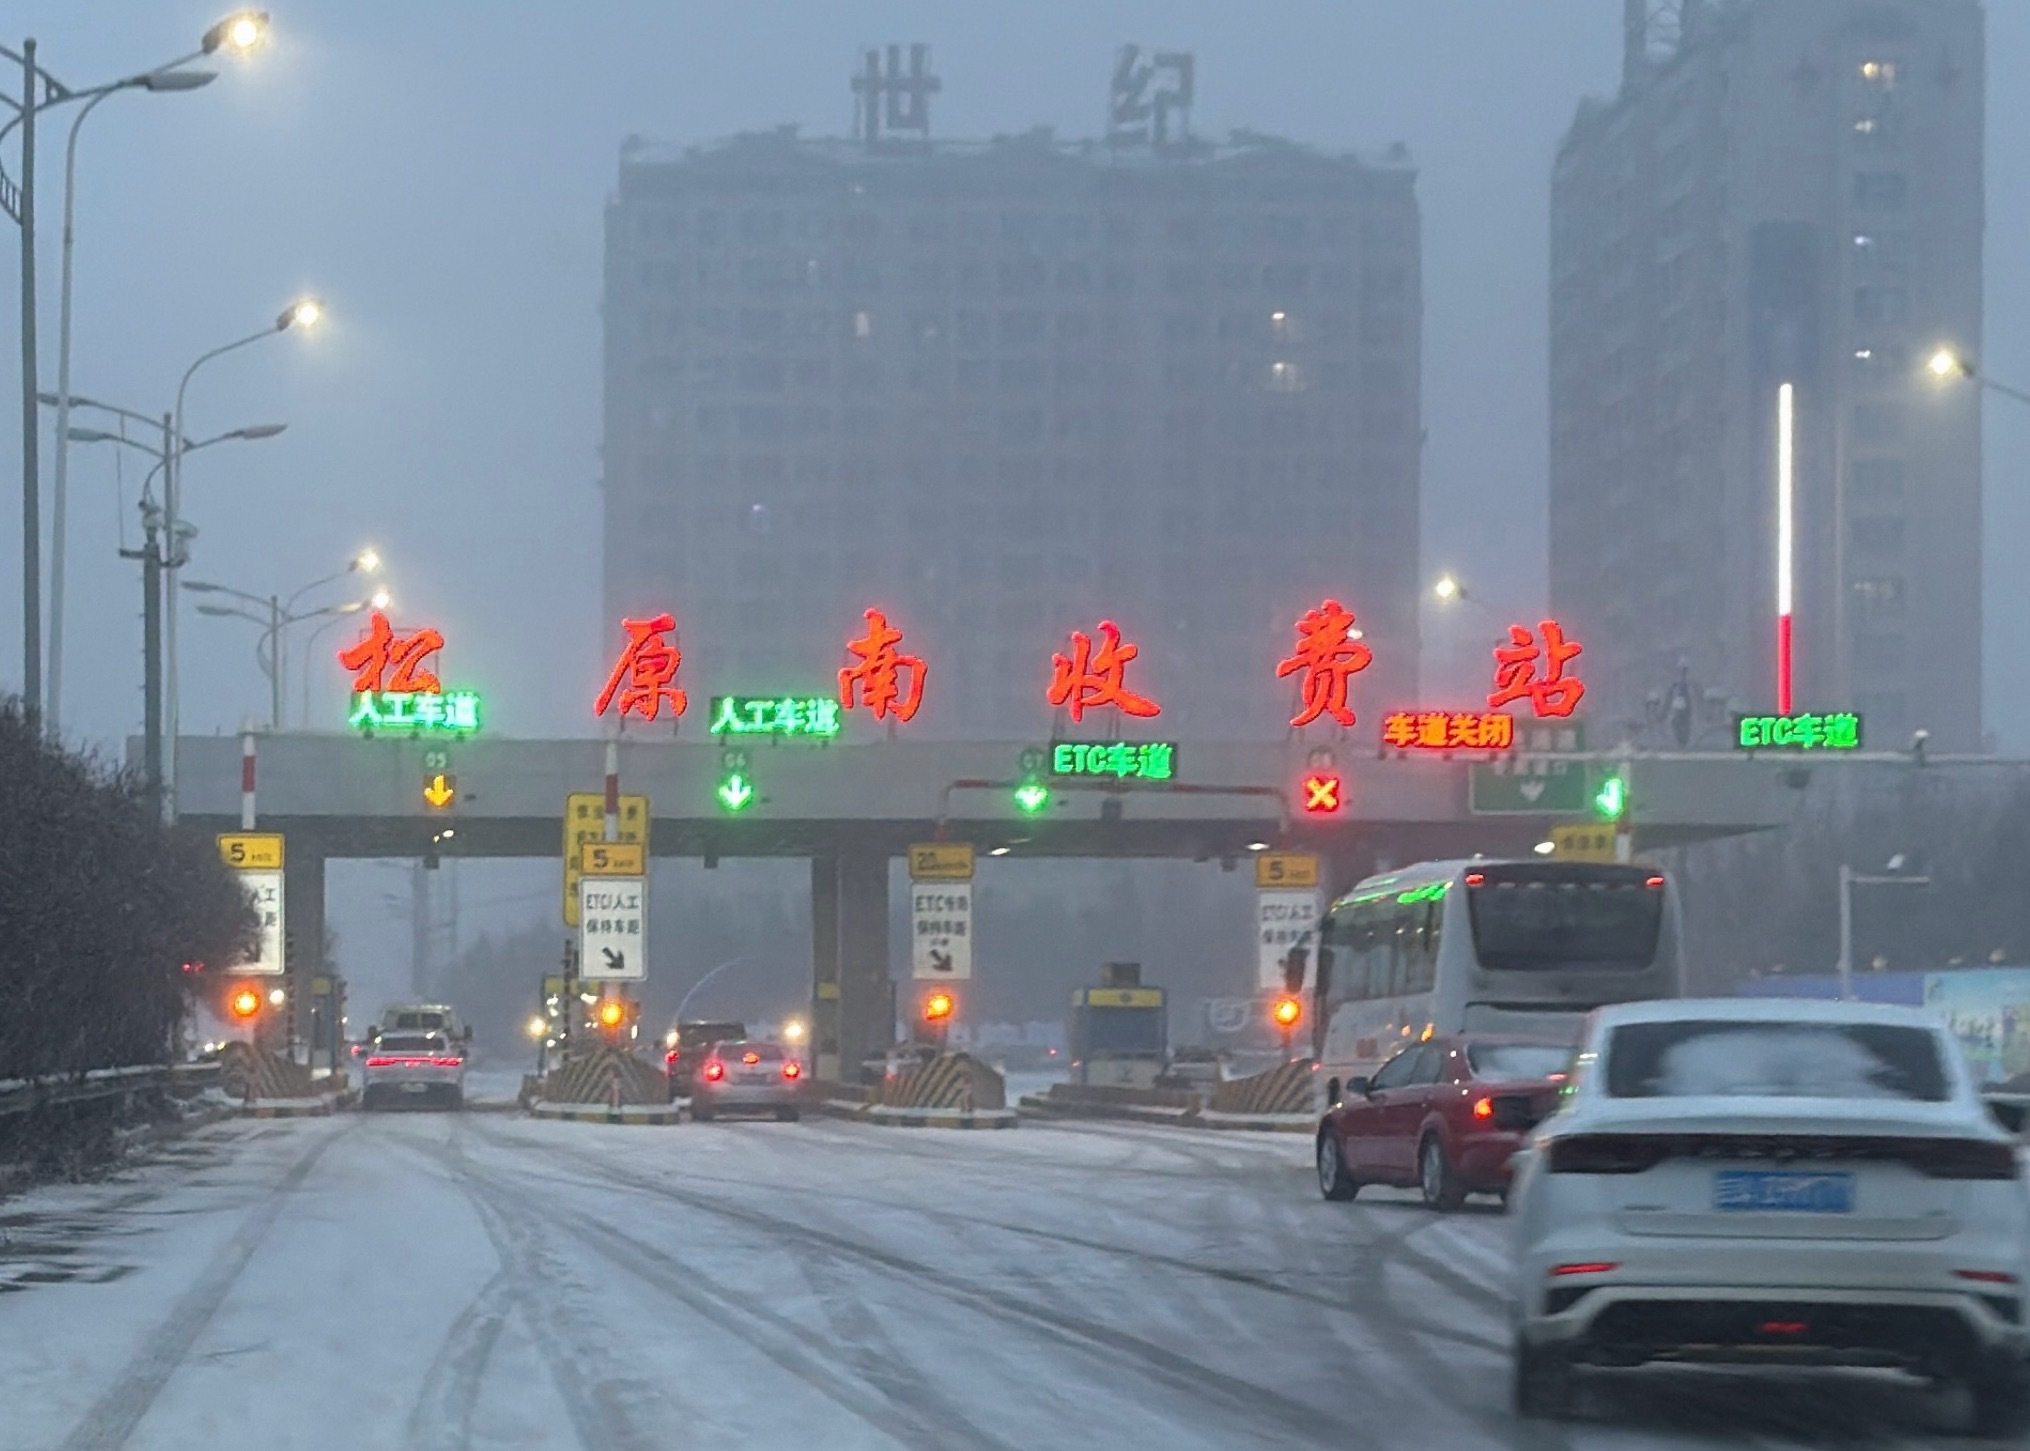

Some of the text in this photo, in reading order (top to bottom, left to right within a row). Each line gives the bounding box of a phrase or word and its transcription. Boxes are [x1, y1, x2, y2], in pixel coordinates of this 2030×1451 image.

[336, 599, 1586, 726] 松原南收费站
[348, 691, 478, 730] 人工车道
[711, 698, 839, 736] 人工车道
[1385, 711, 1512, 748] 车道关闭
[1740, 713, 1859, 749] ETC车道
[1053, 742, 1174, 779] ETC车道
[230, 842, 246, 862] 5
[593, 848, 609, 868] 5
[1268, 860, 1284, 880] 5
